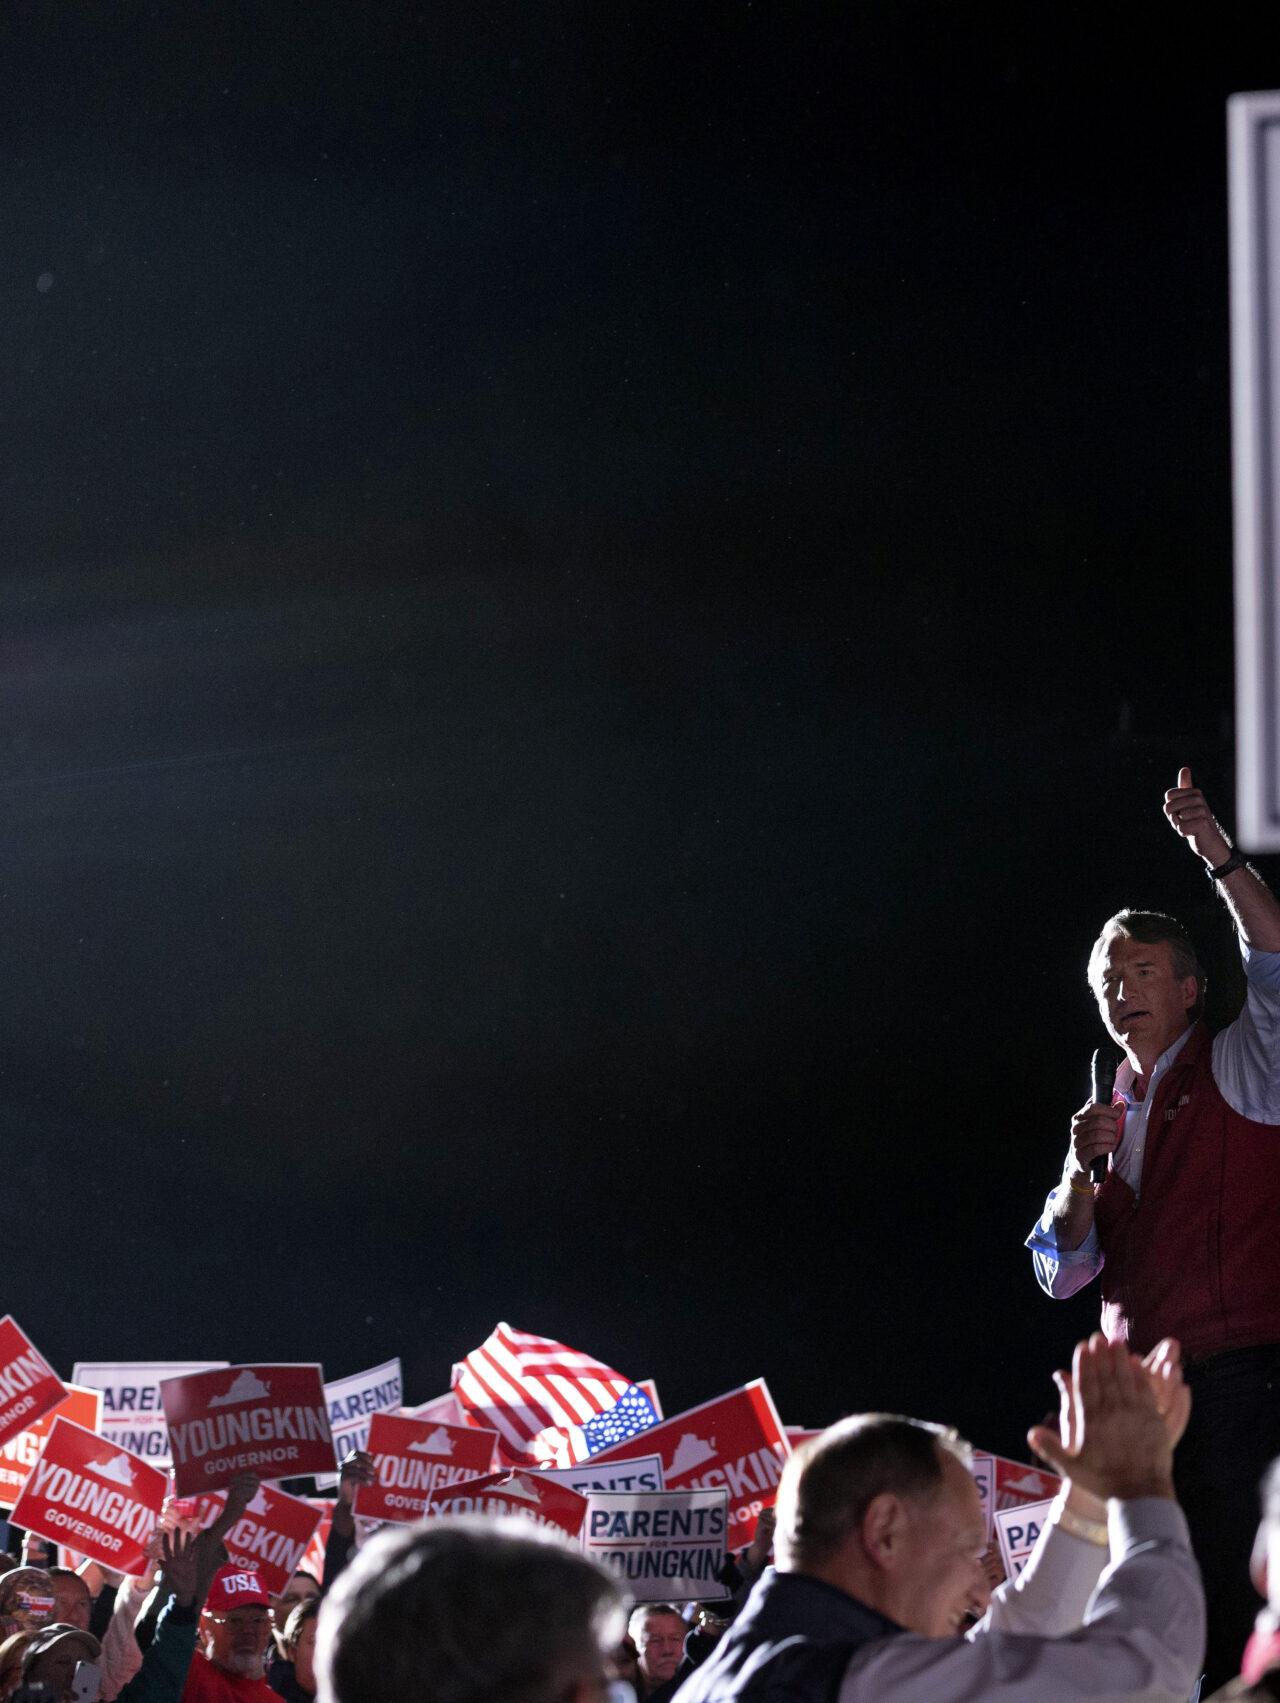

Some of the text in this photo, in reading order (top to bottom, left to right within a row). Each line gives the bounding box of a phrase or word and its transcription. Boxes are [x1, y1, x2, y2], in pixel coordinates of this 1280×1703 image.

[330, 1377, 400, 1424] ARENTS
[170, 1405, 332, 1464] YOUNGKIN
[204, 1445, 299, 1475] GOVERNOR
[44, 1508, 123, 1552] GOVERNOR
[590, 1507, 724, 1538] PARENTS
[222, 1574, 262, 1594] USA
